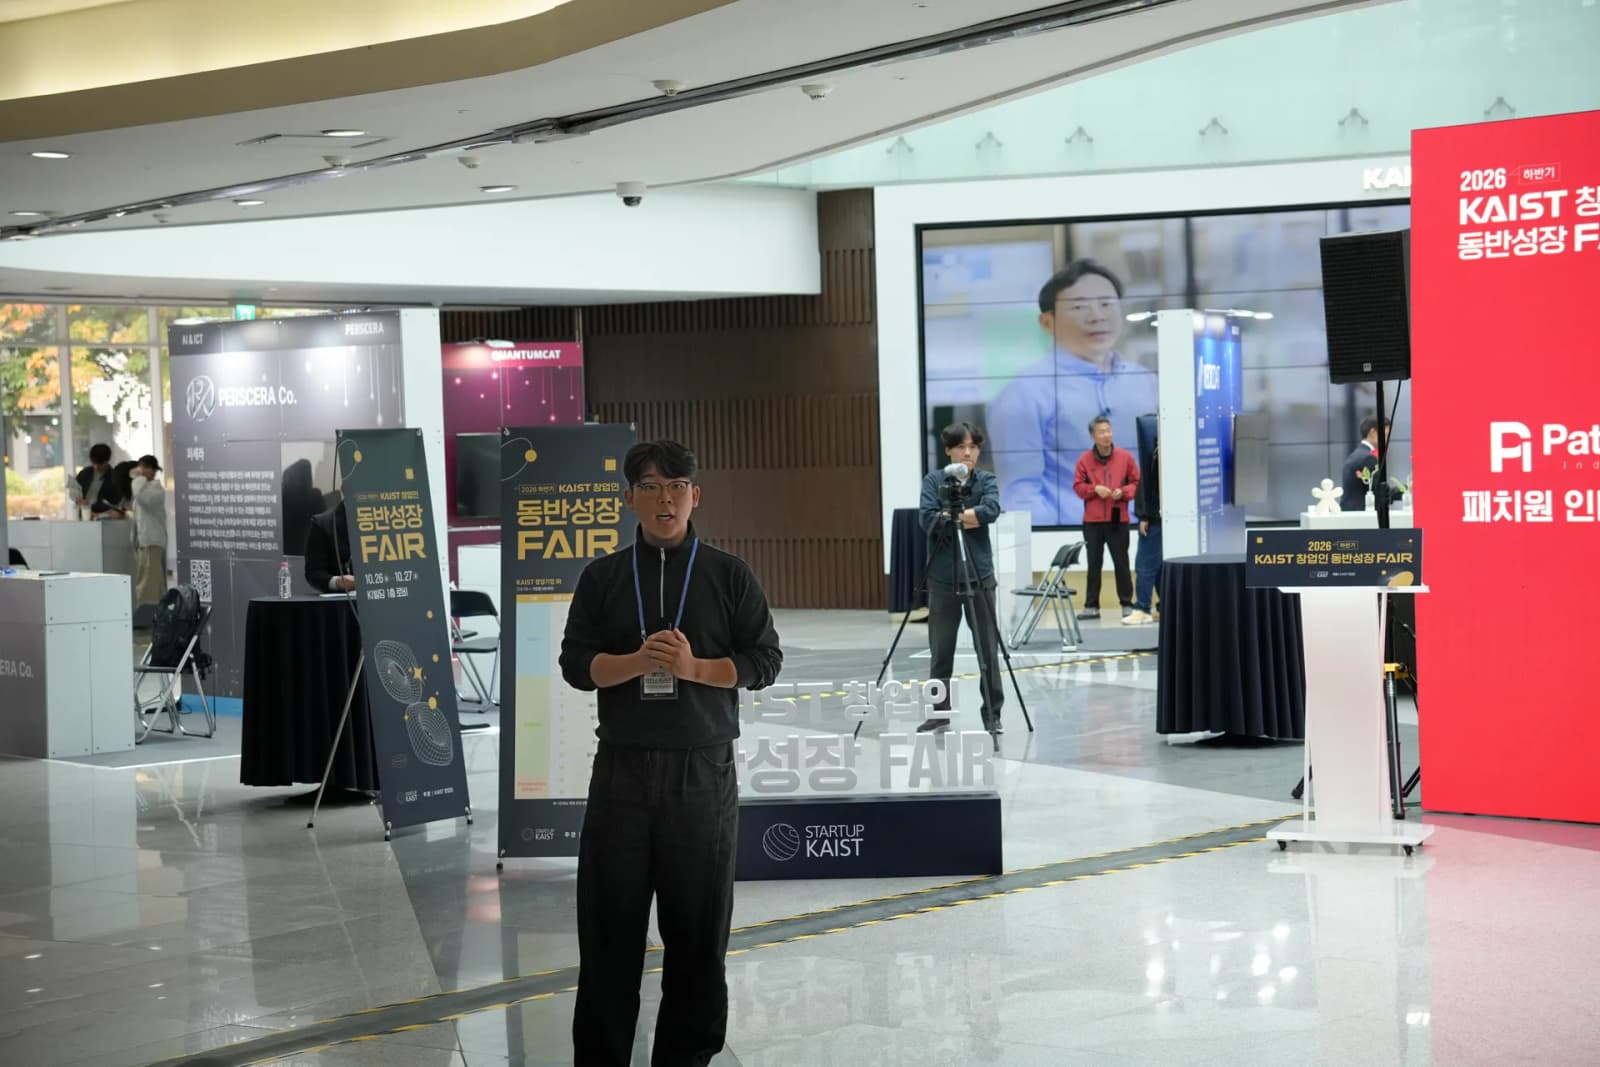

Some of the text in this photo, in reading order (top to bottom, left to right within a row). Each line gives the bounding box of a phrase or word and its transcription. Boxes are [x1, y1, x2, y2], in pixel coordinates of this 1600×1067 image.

[1460, 166, 1555, 192] 2026 하반기
[1459, 190, 1568, 226] KAIST
[1457, 222, 1600, 261] 동반성장 F
[345, 322, 384, 336] PERSCERA
[492, 349, 561, 361] QUANTUMCAT
[218, 386, 277, 407] PERSCERA
[278, 385, 297, 405] Co.
[1542, 422, 1600, 456] Pat
[558, 483, 591, 493] KAIST
[593, 482, 619, 493] 창업인
[356, 504, 423, 531] 동반성장
[516, 497, 622, 526] 동반성장
[1462, 489, 1600, 523] 패치원 인
[360, 532, 427, 563] FAIR
[517, 528, 619, 560] FAIR
[1308, 541, 1332, 552] 2026
[1254, 552, 1413, 564] KAIST 창업인 동반성장 FAIR
[365, 572, 384, 585] 10.26
[395, 570, 412, 582] 10.27
[19, 660, 34, 679] Co.
[841, 678, 960, 722] 창업인
[879, 730, 995, 790] FAIR
[805, 824, 865, 838] STARTUP
[806, 838, 864, 858] KAIST
